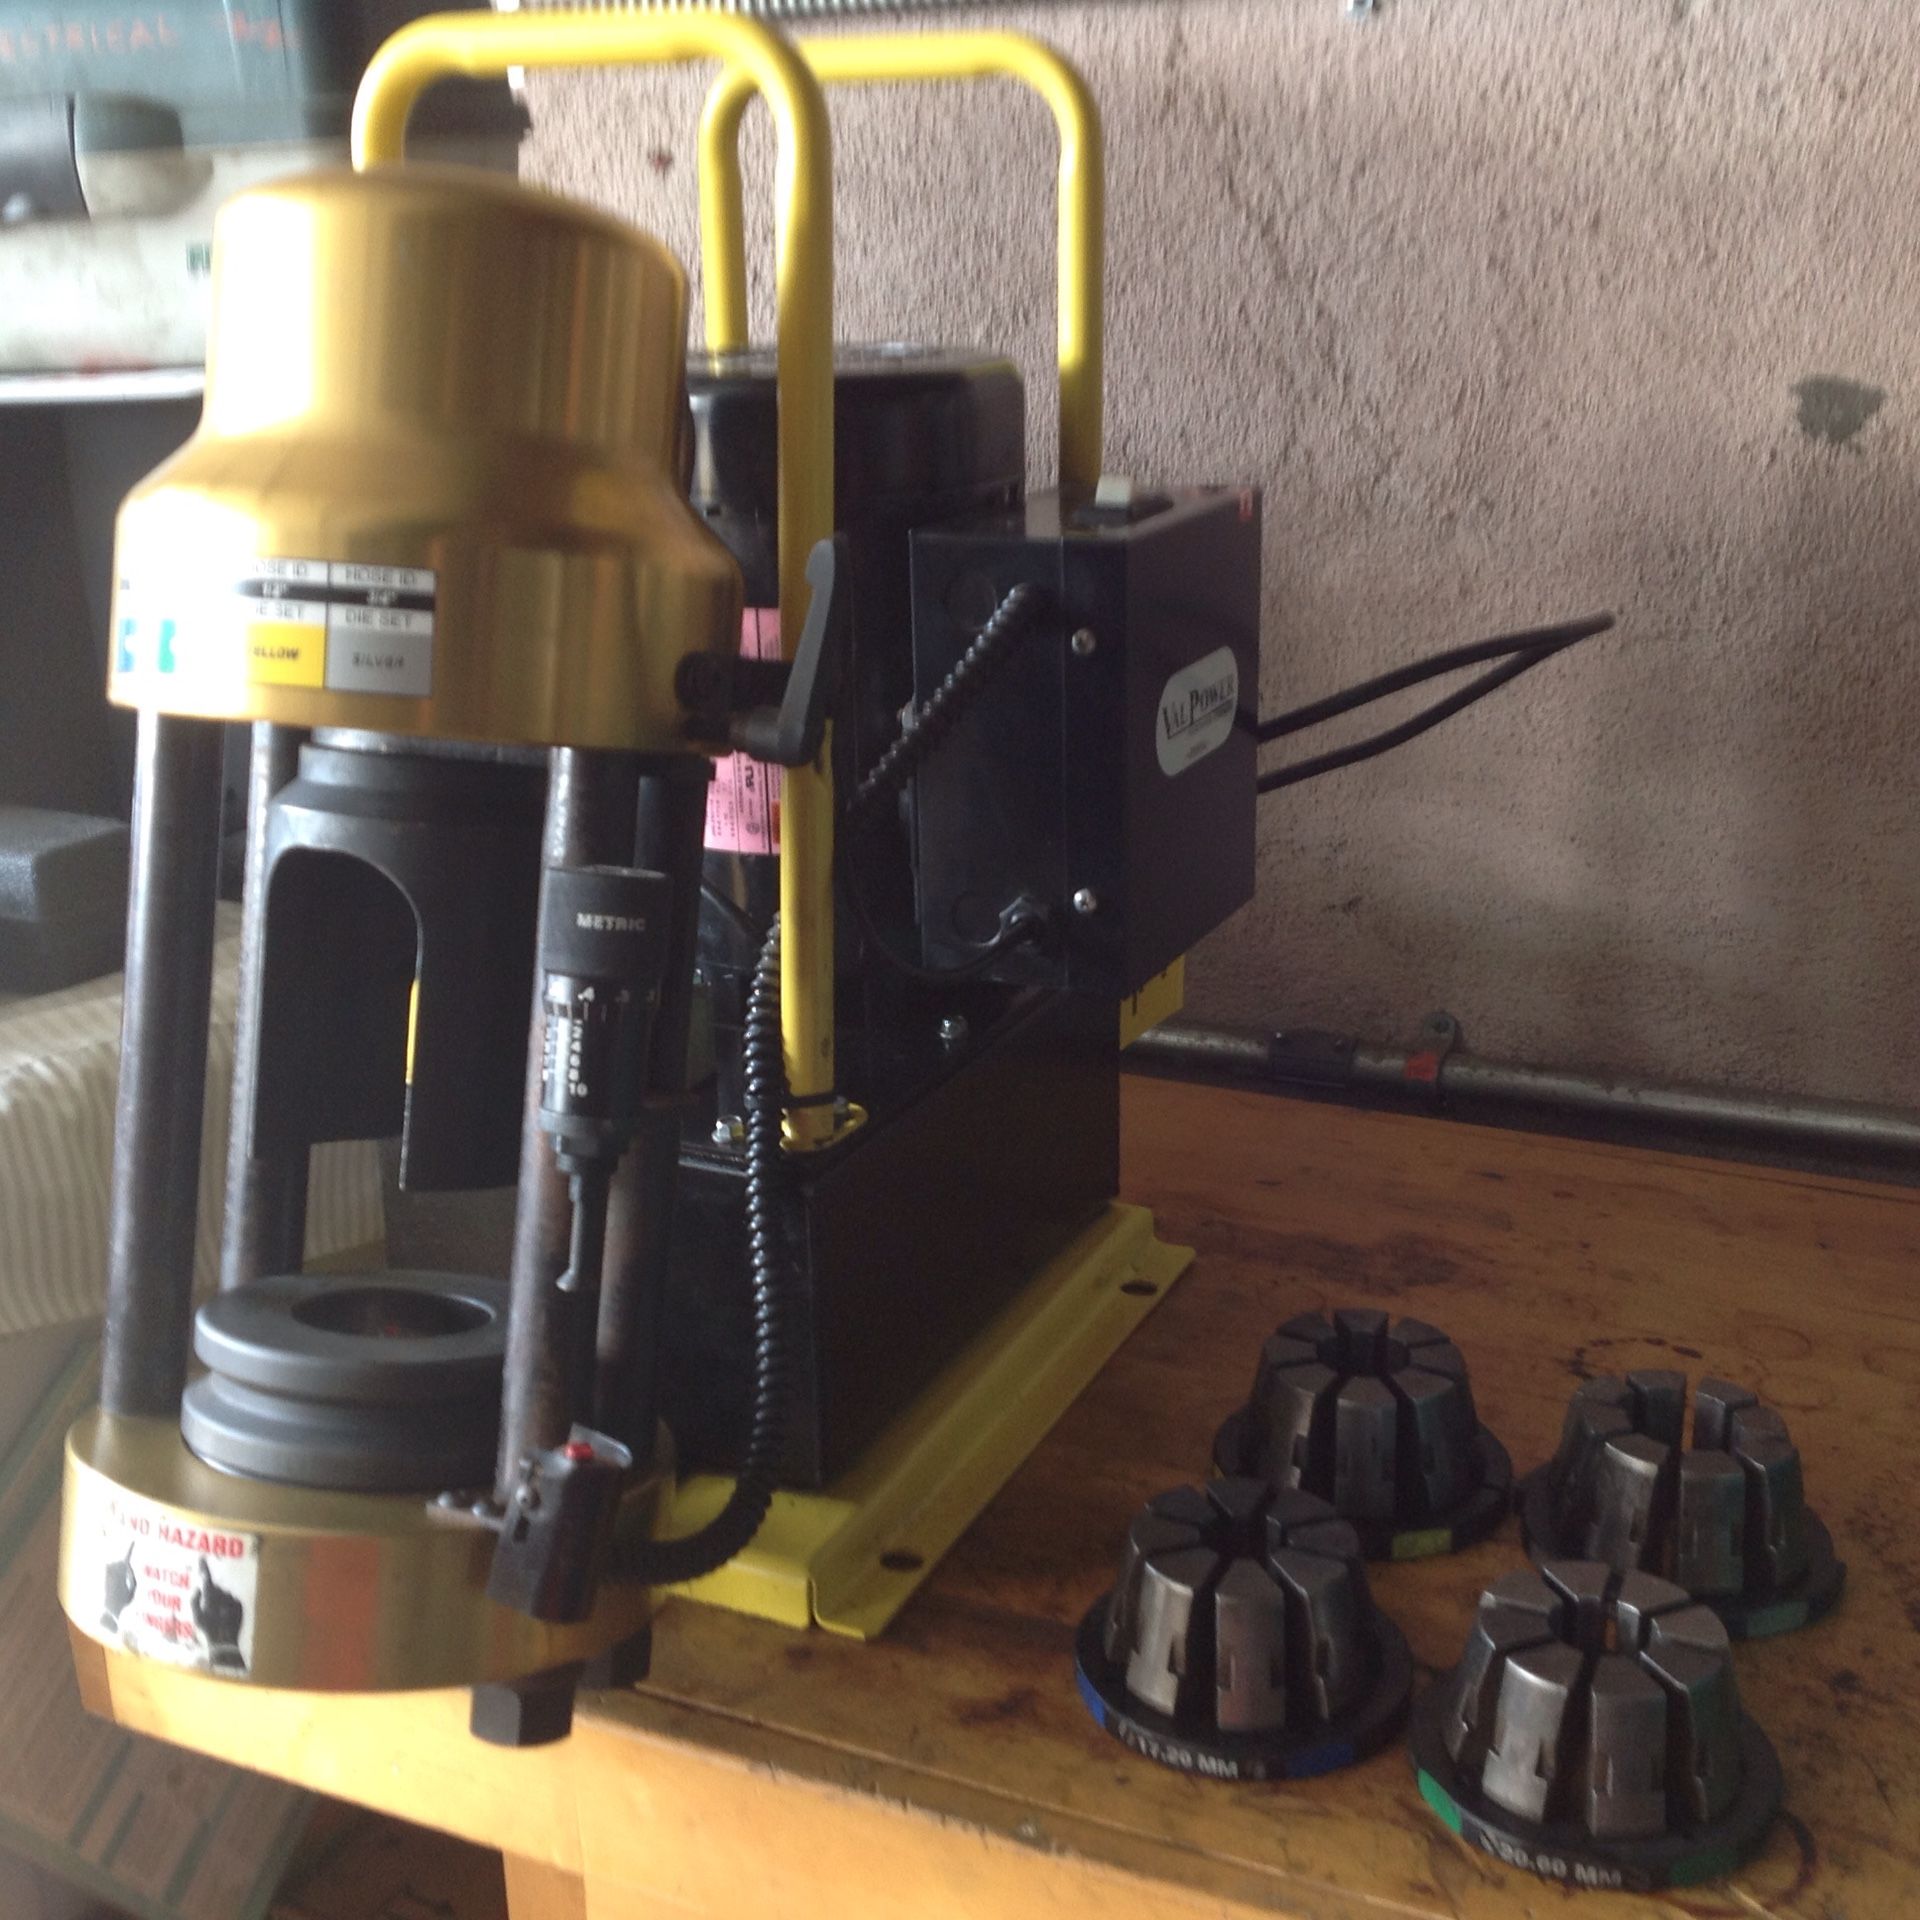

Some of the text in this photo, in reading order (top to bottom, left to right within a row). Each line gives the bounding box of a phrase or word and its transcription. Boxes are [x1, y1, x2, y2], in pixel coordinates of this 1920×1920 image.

[576, 911, 647, 932] METRIC
[568, 1082, 588, 1098] 10
[158, 1523, 245, 1558] HAZARD
[1197, 1753, 1239, 1779] MM
